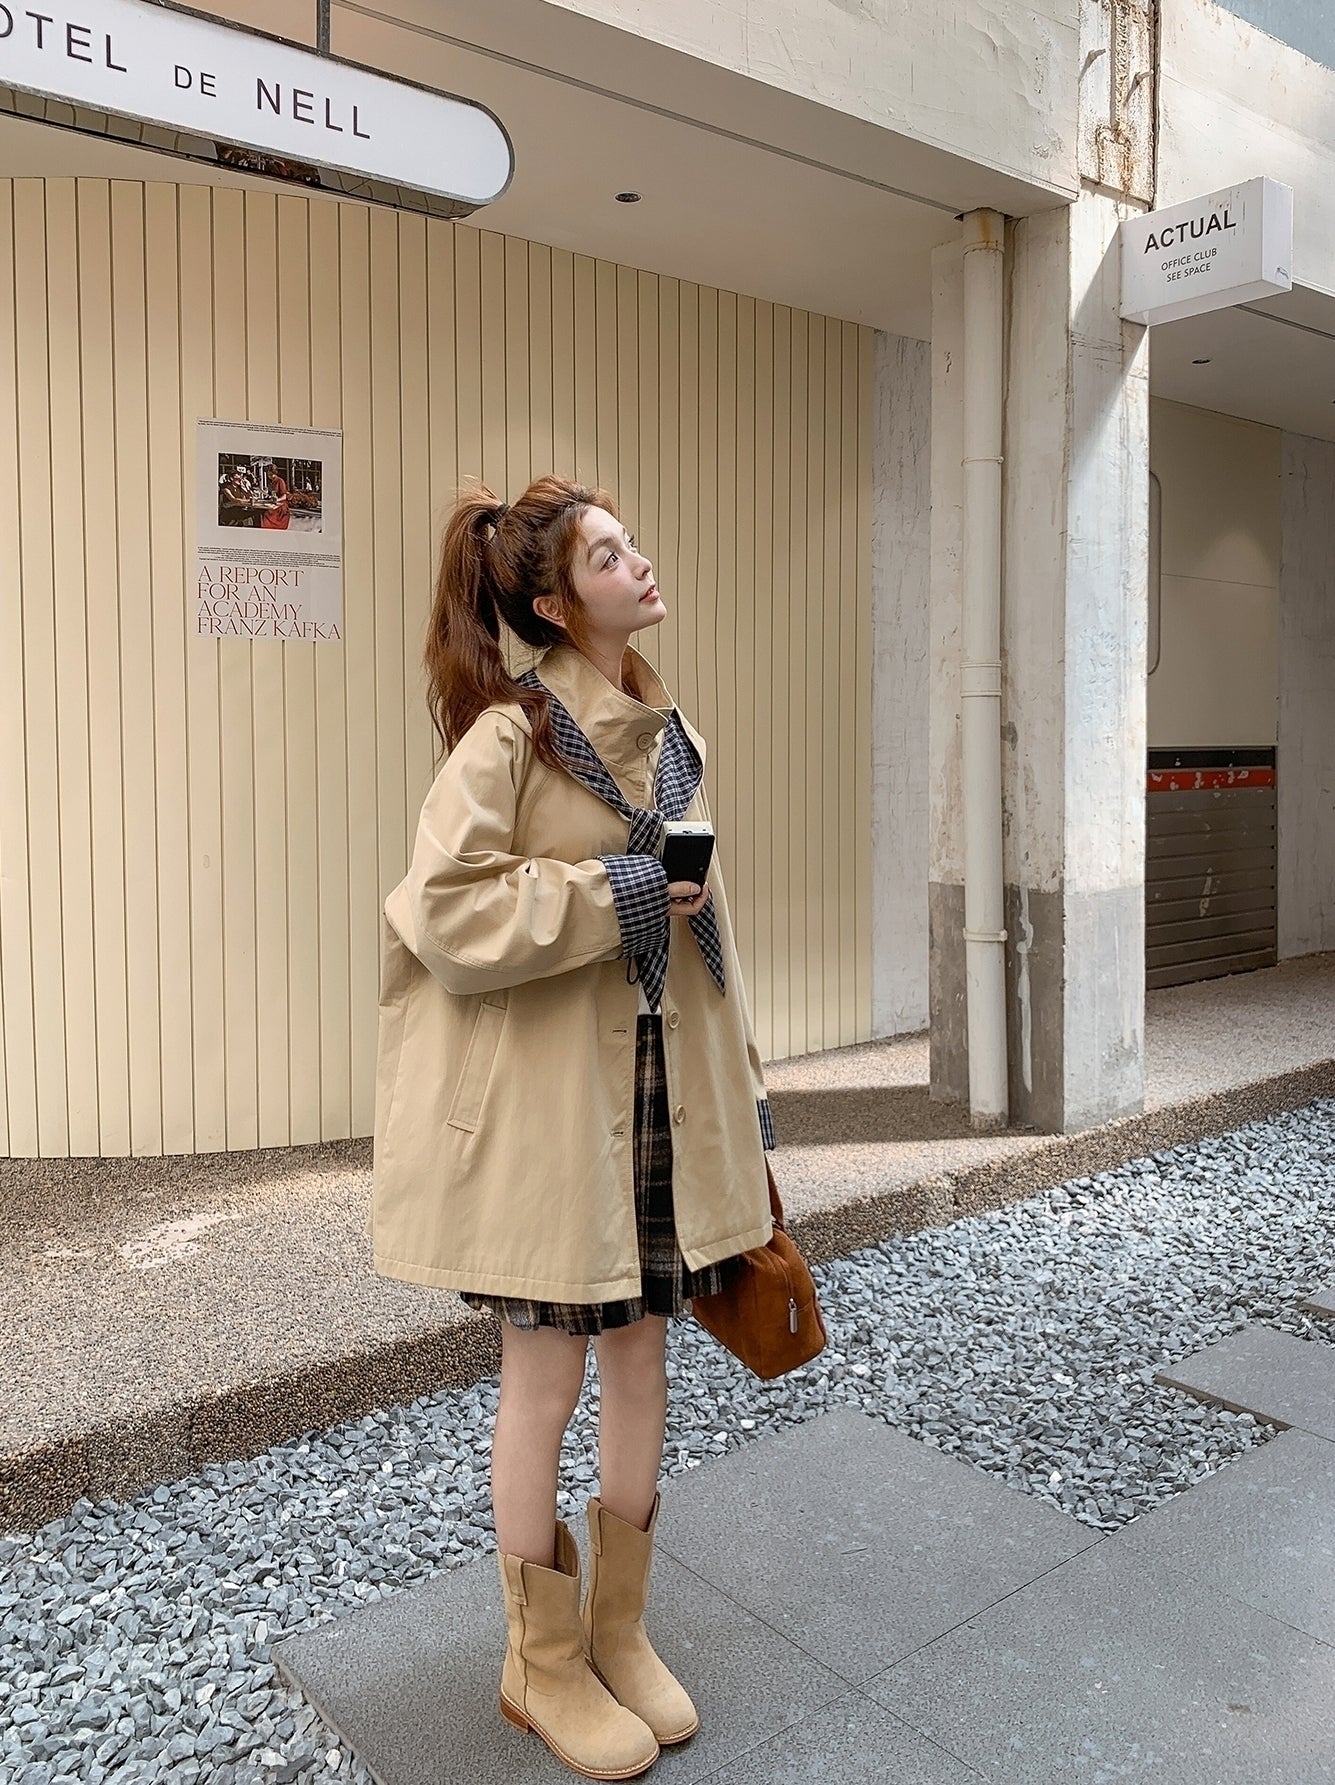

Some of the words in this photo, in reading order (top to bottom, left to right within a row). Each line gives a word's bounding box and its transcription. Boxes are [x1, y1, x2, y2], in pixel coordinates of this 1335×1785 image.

[174, 64, 217, 98] DE
[256, 77, 370, 140] NELL
[1144, 210, 1237, 254] ACTUAL
[1161, 255, 1191, 271] OFFICE
[1194, 247, 1217, 262] CLUB
[1166, 271, 1182, 283] SEE
[1184, 262, 1211, 278] SPACE
[198, 565, 213, 582] A
[219, 566, 304, 587] REPORT
[198, 583, 241, 600] FOR
[247, 585, 277, 602] AN
[198, 600, 302, 620] ACADEMY
[198, 618, 267, 636] FRANZ
[273, 620, 341, 640] KAFKA
